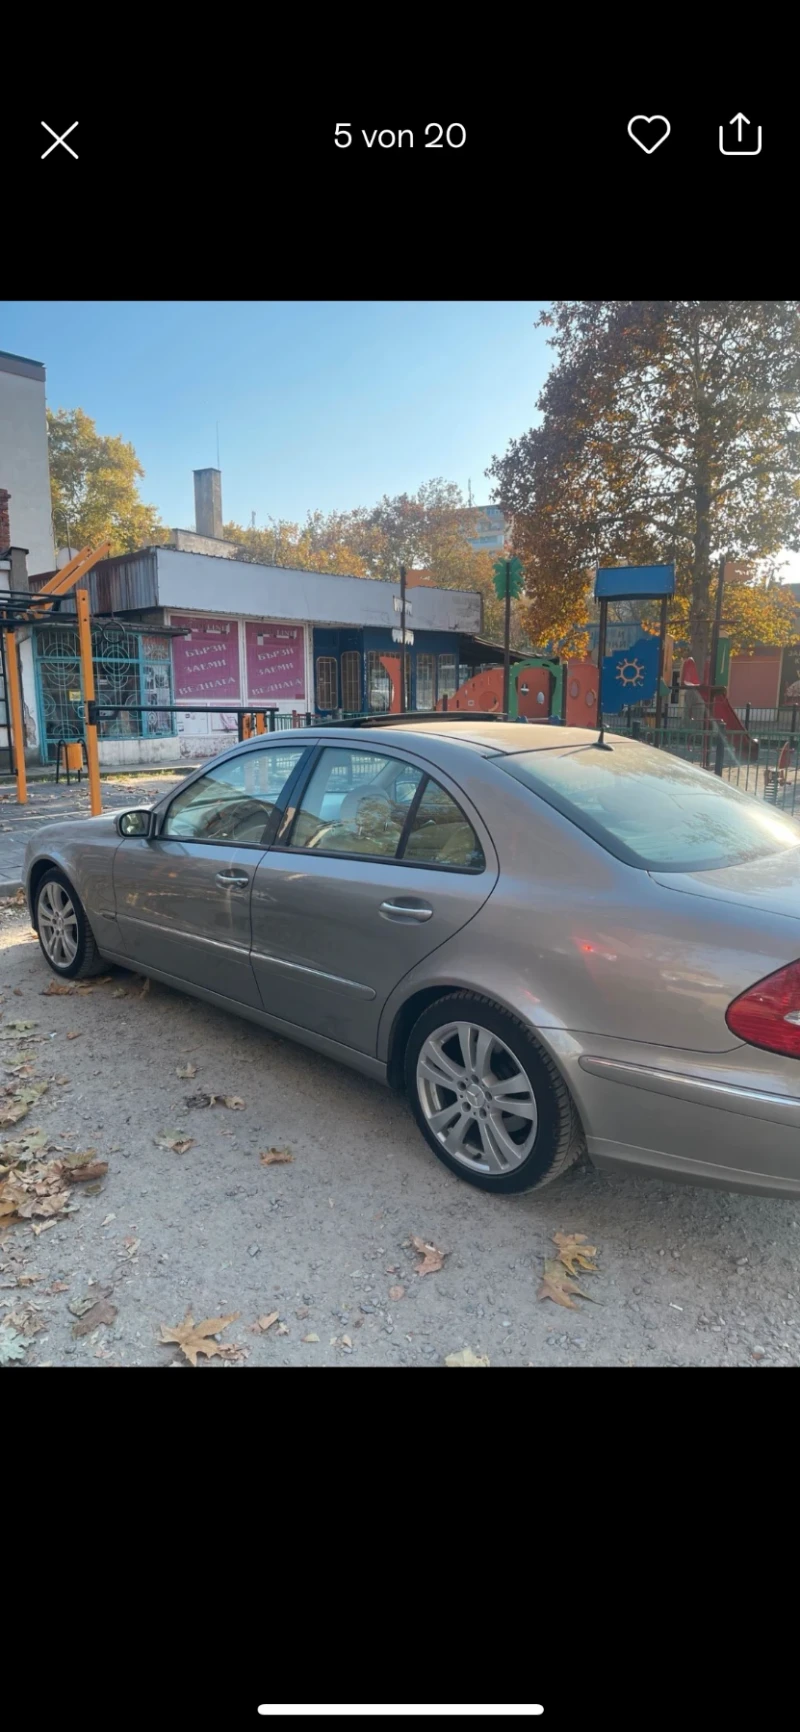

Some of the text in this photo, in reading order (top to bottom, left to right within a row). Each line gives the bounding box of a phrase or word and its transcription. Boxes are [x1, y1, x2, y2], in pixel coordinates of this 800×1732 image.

[185, 644, 227, 658] БЪРЗИ
[257, 647, 294, 661] БЪРЗИ
[184, 659, 227, 673] ЗАЕМИ
[257, 662, 294, 676] ЗАЕМИ
[178, 677, 236, 695] ВЕДНАГА
[251, 678, 303, 696] ВЕДНАГА
